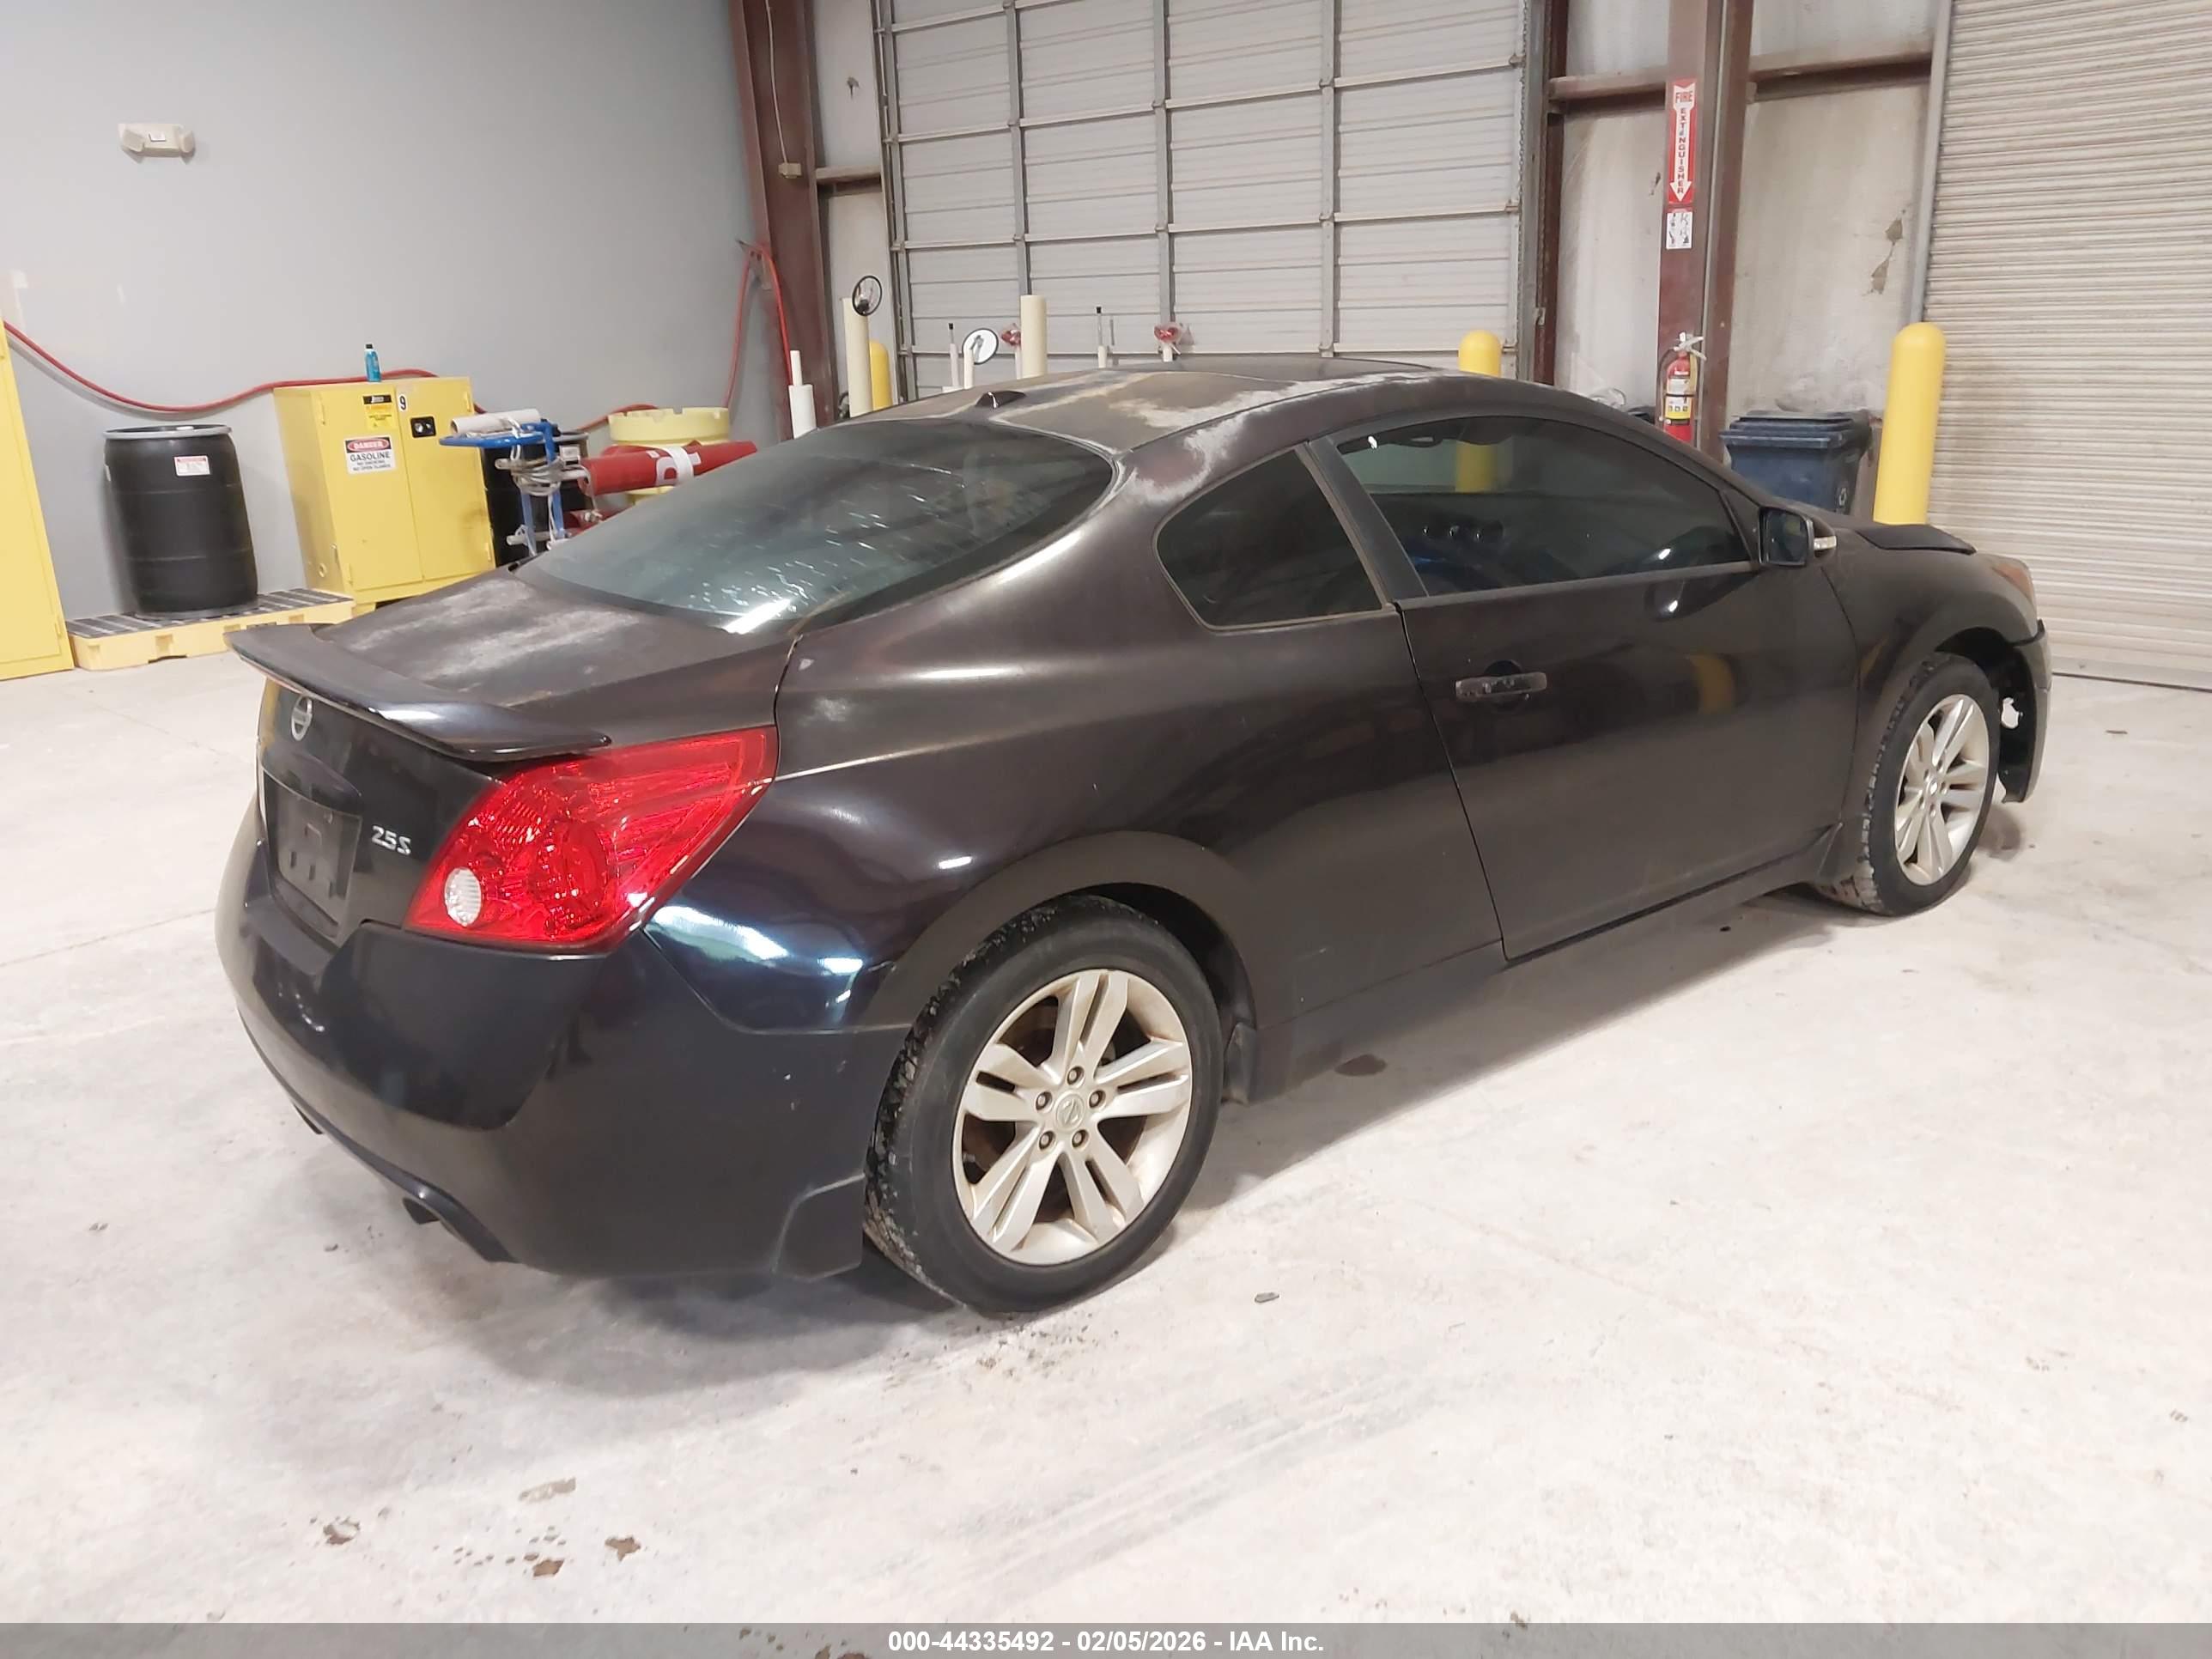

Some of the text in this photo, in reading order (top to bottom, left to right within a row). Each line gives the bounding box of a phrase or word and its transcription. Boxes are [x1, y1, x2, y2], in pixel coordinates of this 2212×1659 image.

[1675, 91, 1693, 103] FIRE
[399, 395, 407, 410] 9
[349, 451, 391, 462] GASOLINE
